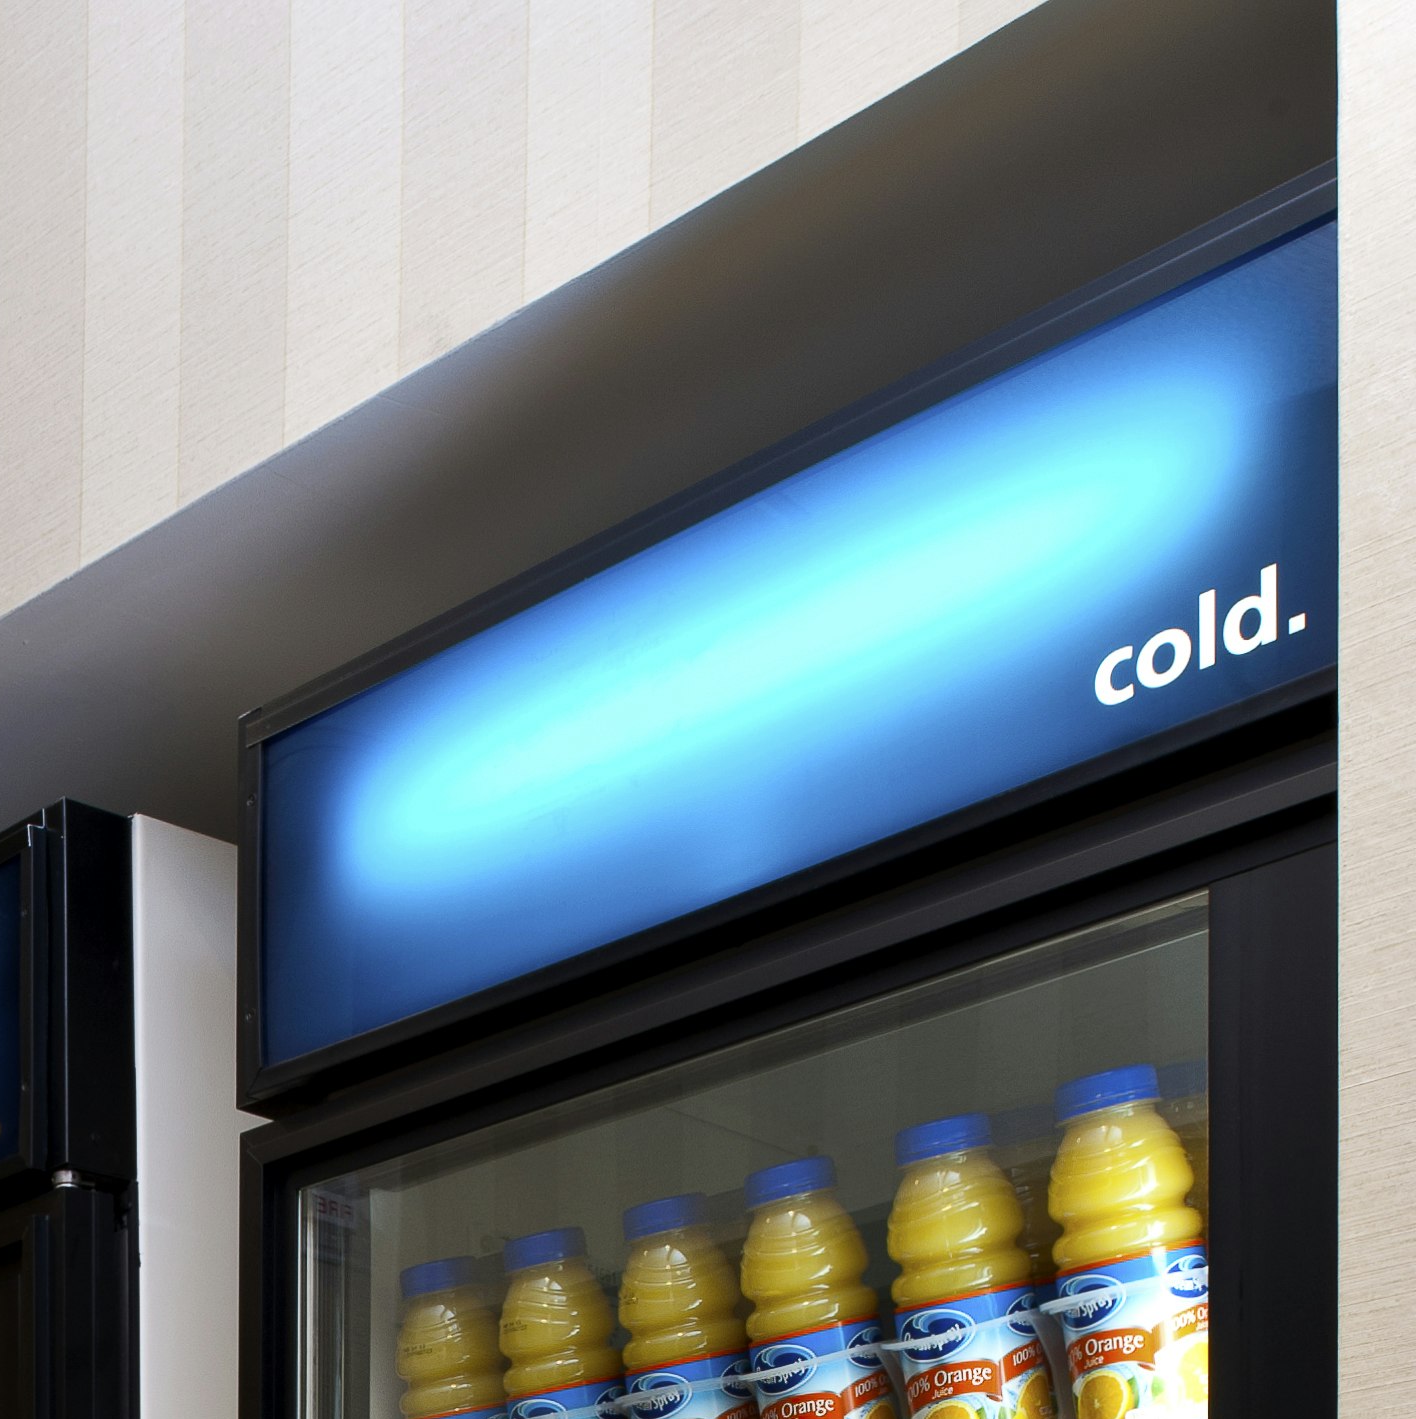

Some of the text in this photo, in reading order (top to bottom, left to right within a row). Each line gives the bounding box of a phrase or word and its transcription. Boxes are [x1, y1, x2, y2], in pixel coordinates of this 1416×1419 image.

[1094, 563, 1306, 706] cold.
[1086, 1332, 1144, 1354] Orange
[934, 1364, 992, 1384] Orange
[781, 1396, 834, 1417] Orange
